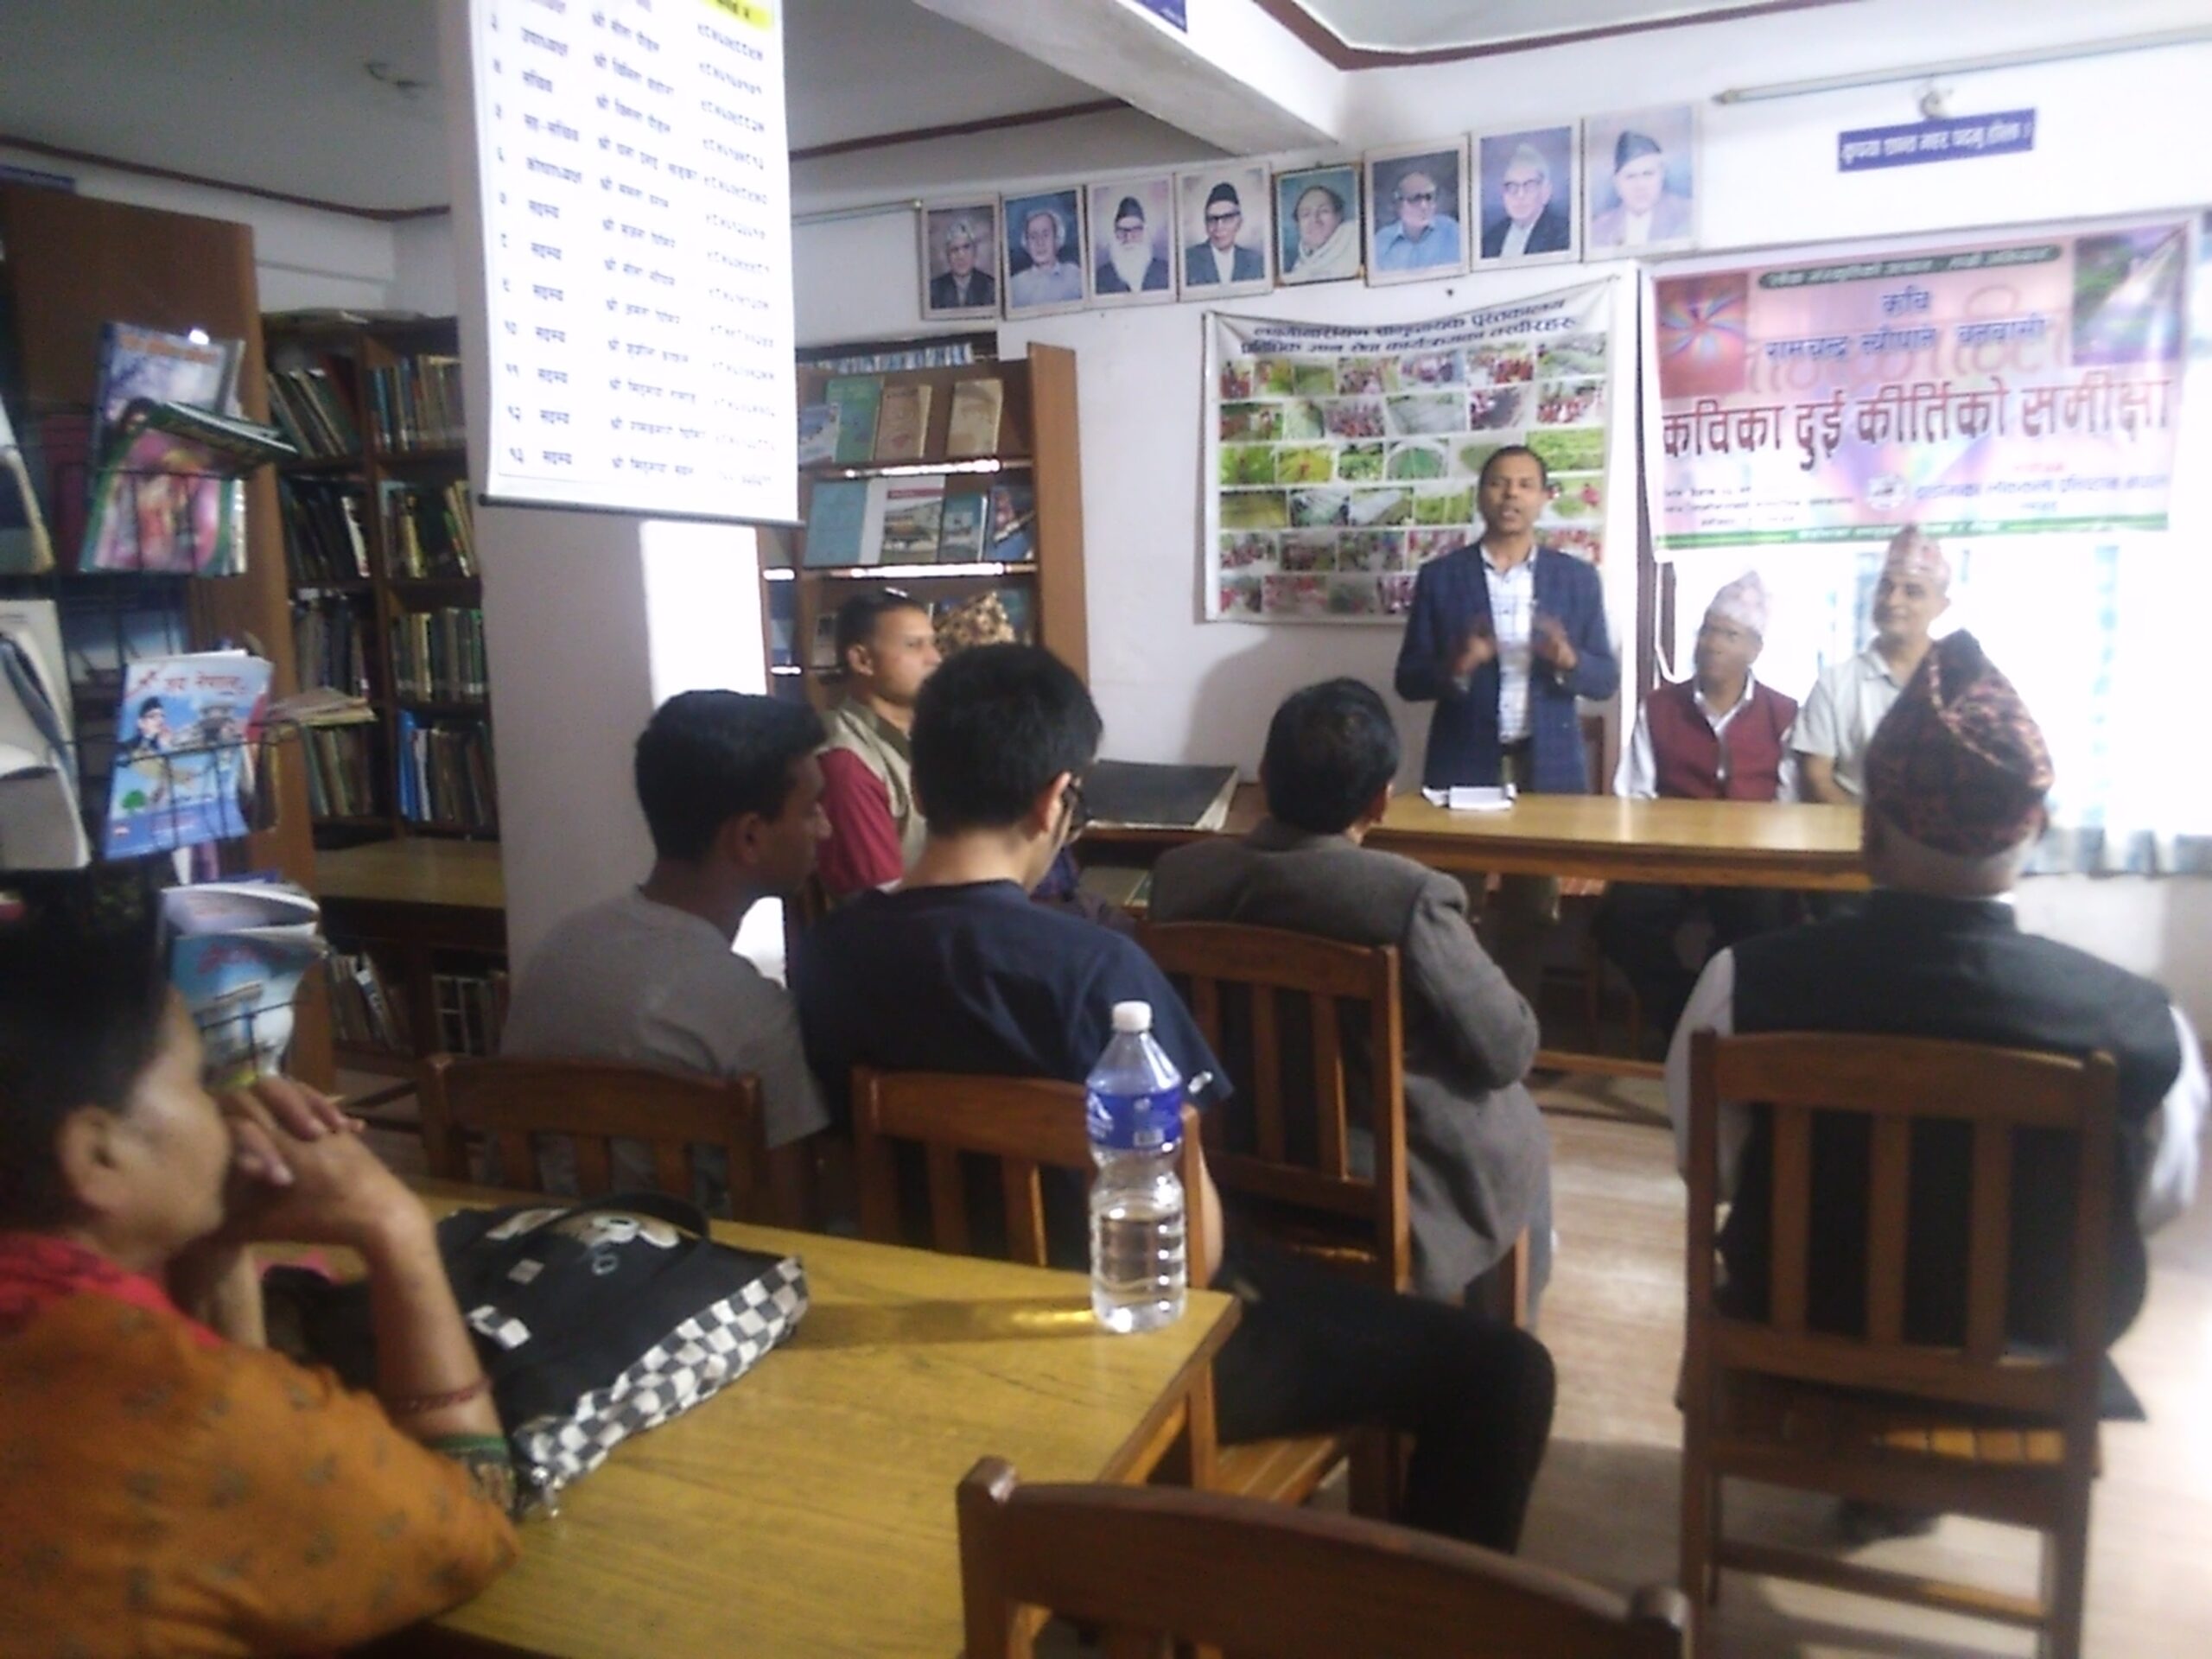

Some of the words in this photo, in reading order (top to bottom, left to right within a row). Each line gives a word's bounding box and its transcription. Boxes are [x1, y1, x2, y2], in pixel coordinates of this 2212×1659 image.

[1881, 284, 1931, 314] कवि
[1662, 398, 1785, 458] कविका
[1796, 389, 1846, 471] दुई
[1855, 375, 2010, 444] कीर्तिको
[2021, 371, 2171, 442] समीक्षा
